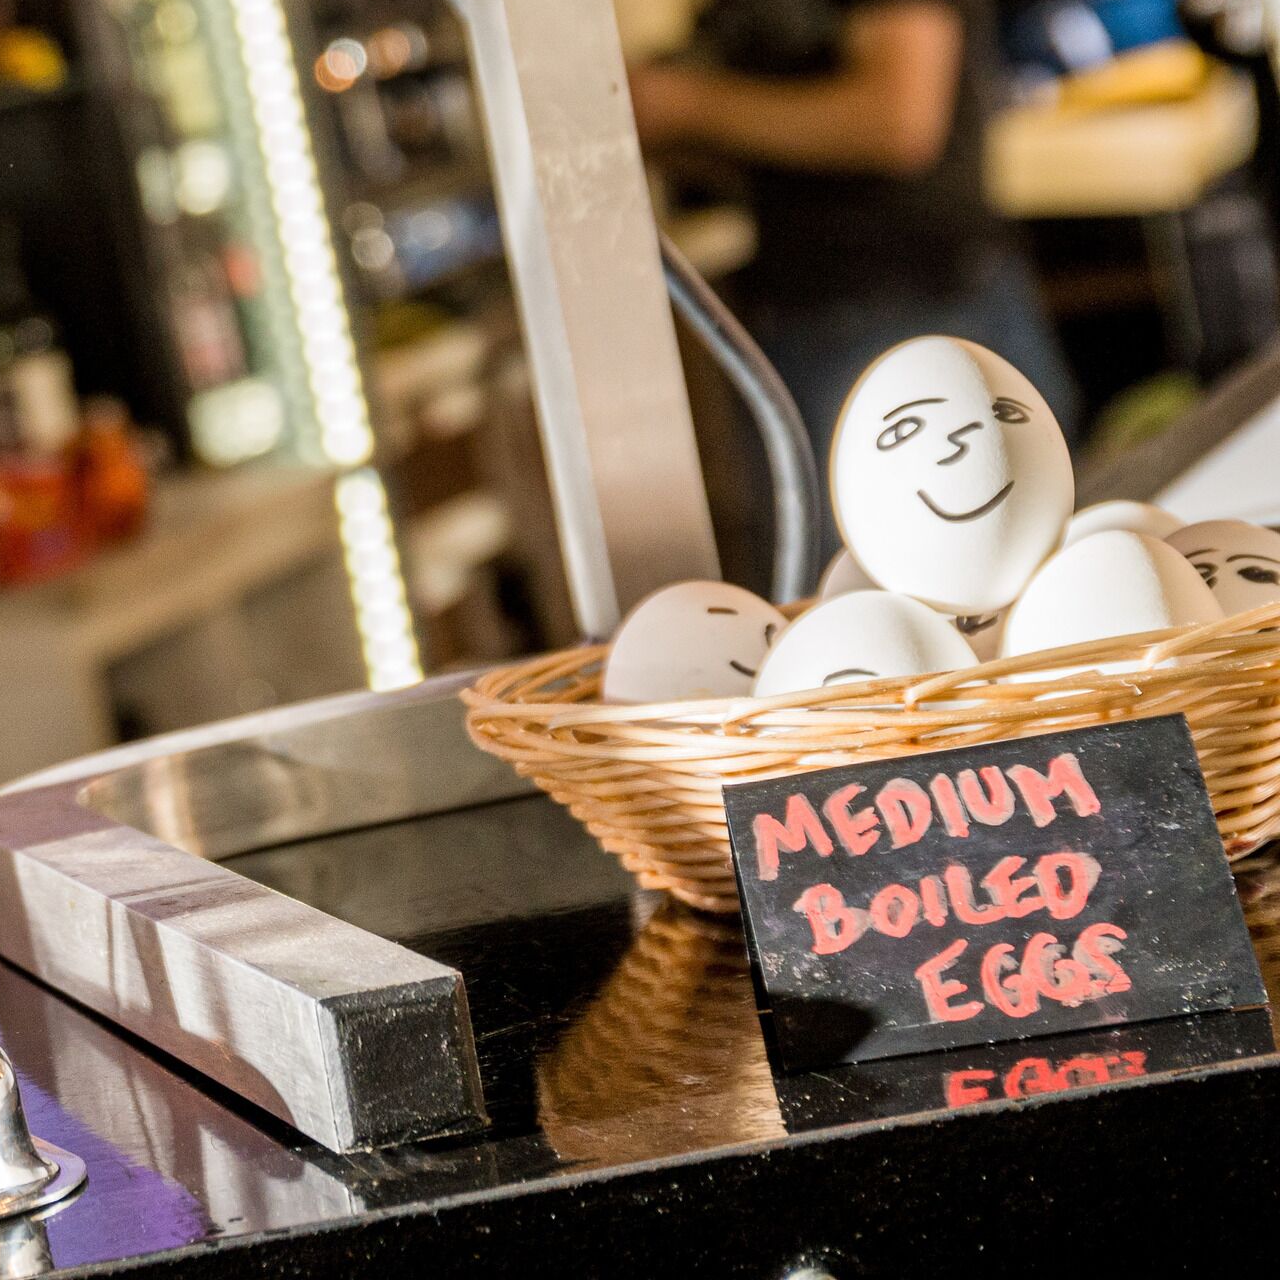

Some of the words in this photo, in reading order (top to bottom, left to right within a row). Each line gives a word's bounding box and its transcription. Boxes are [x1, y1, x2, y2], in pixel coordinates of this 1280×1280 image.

[754, 752, 1101, 881] MEDIUM
[794, 851, 1102, 954] BOILED
[915, 923, 1132, 1022] EGGS
